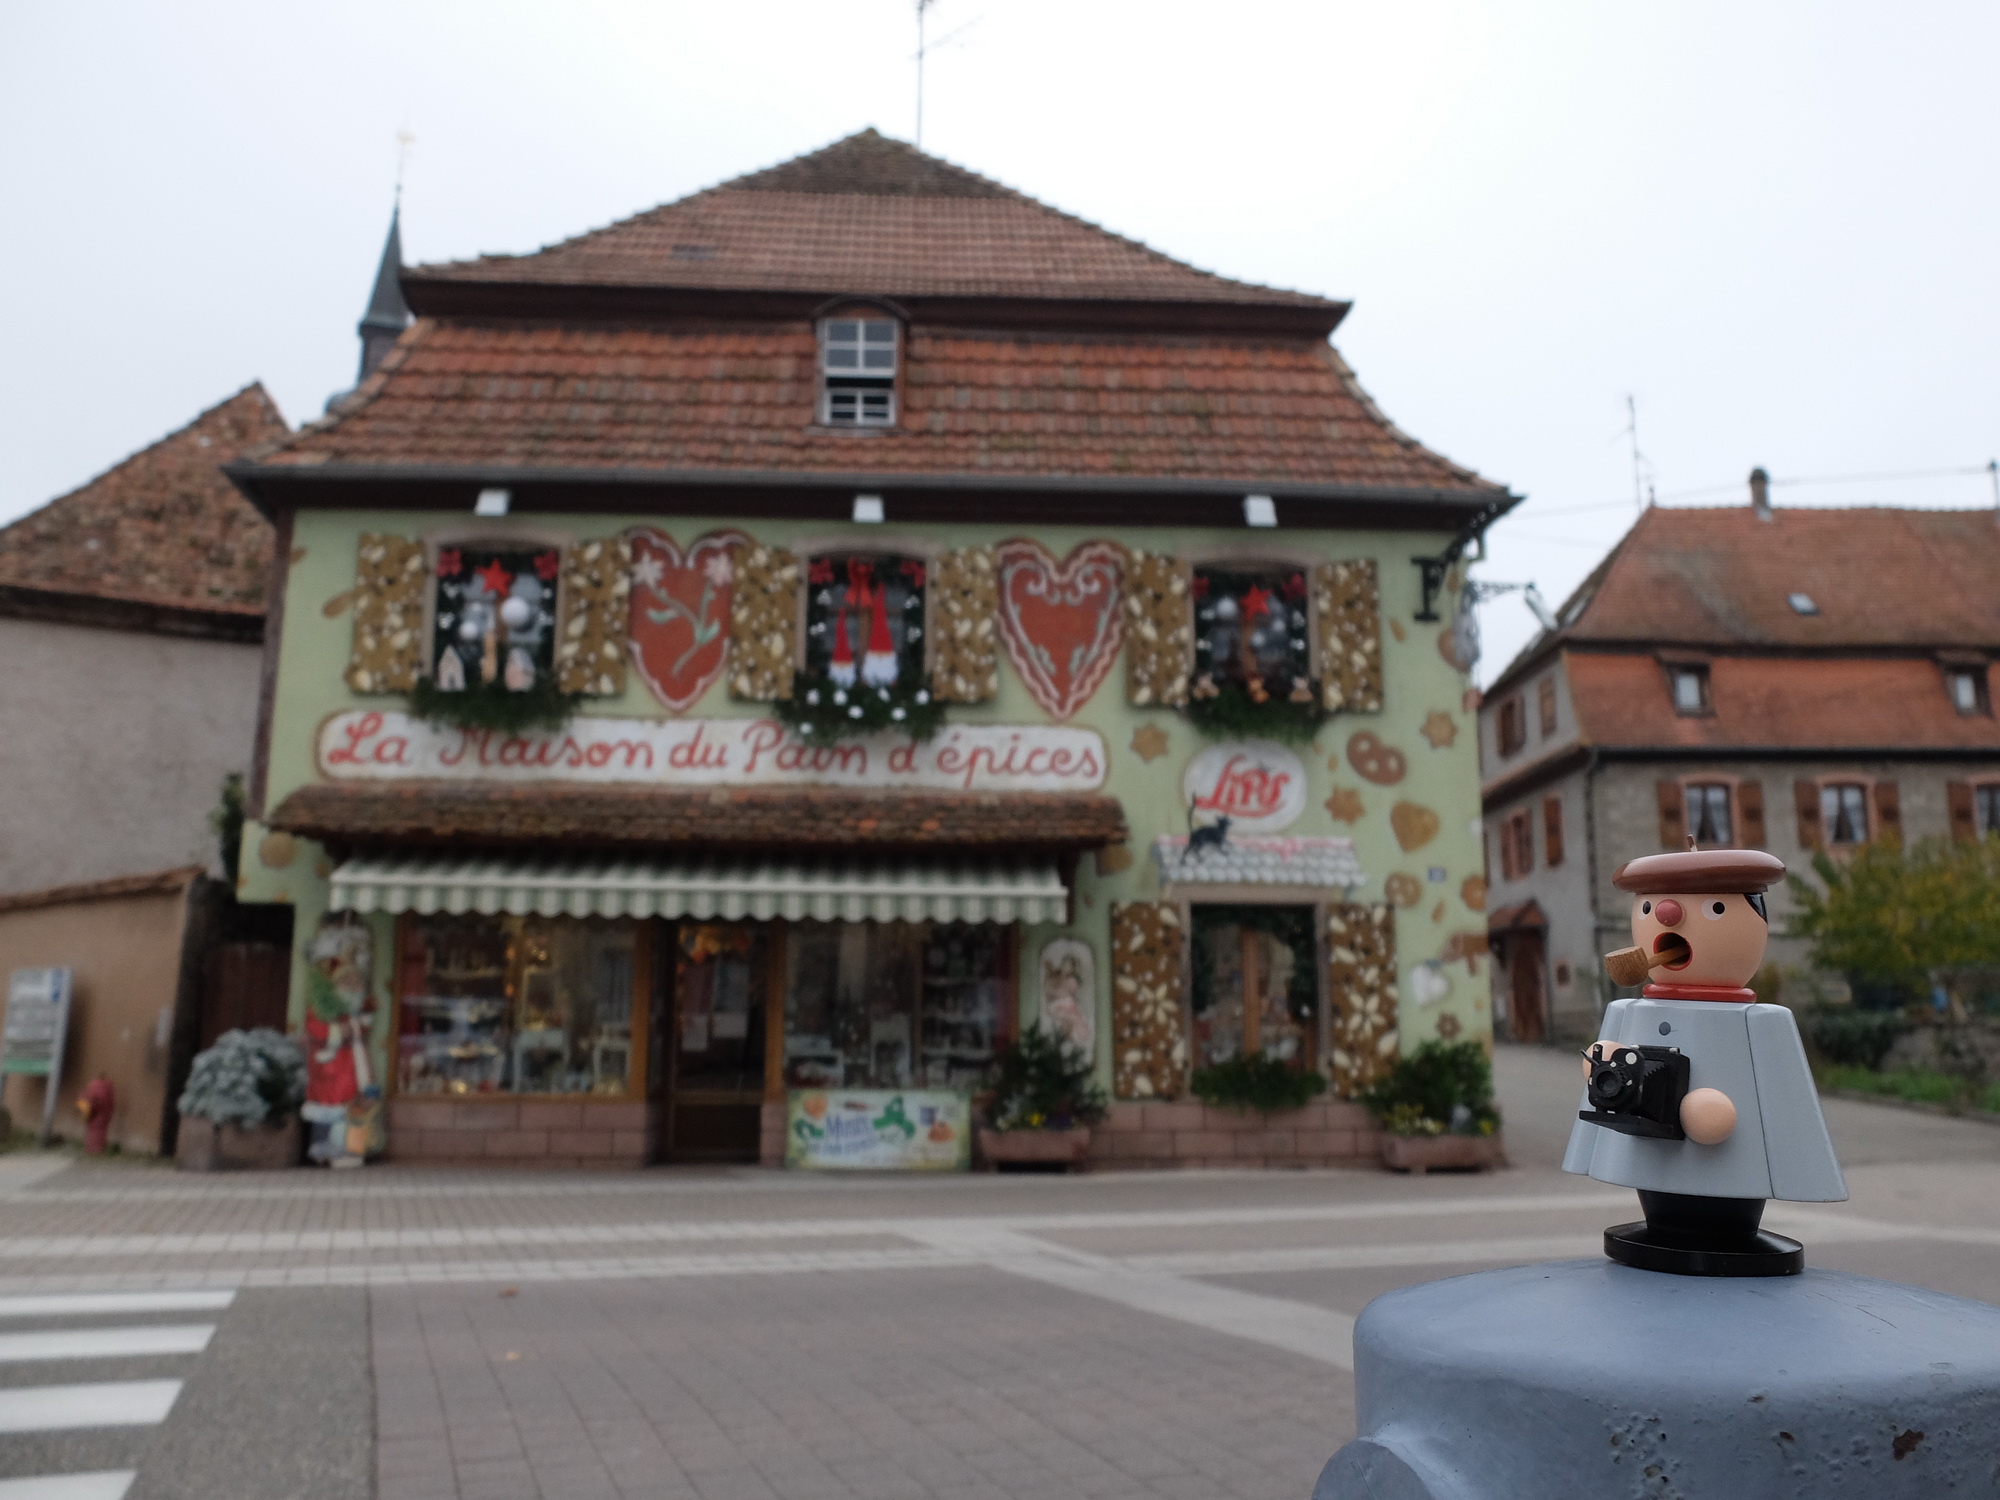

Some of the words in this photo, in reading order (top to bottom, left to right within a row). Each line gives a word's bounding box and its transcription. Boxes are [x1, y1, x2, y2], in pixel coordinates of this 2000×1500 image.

[327, 712, 408, 766] La
[439, 724, 655, 770] Maison
[669, 720, 729, 769] du
[742, 718, 868, 775] Pain
